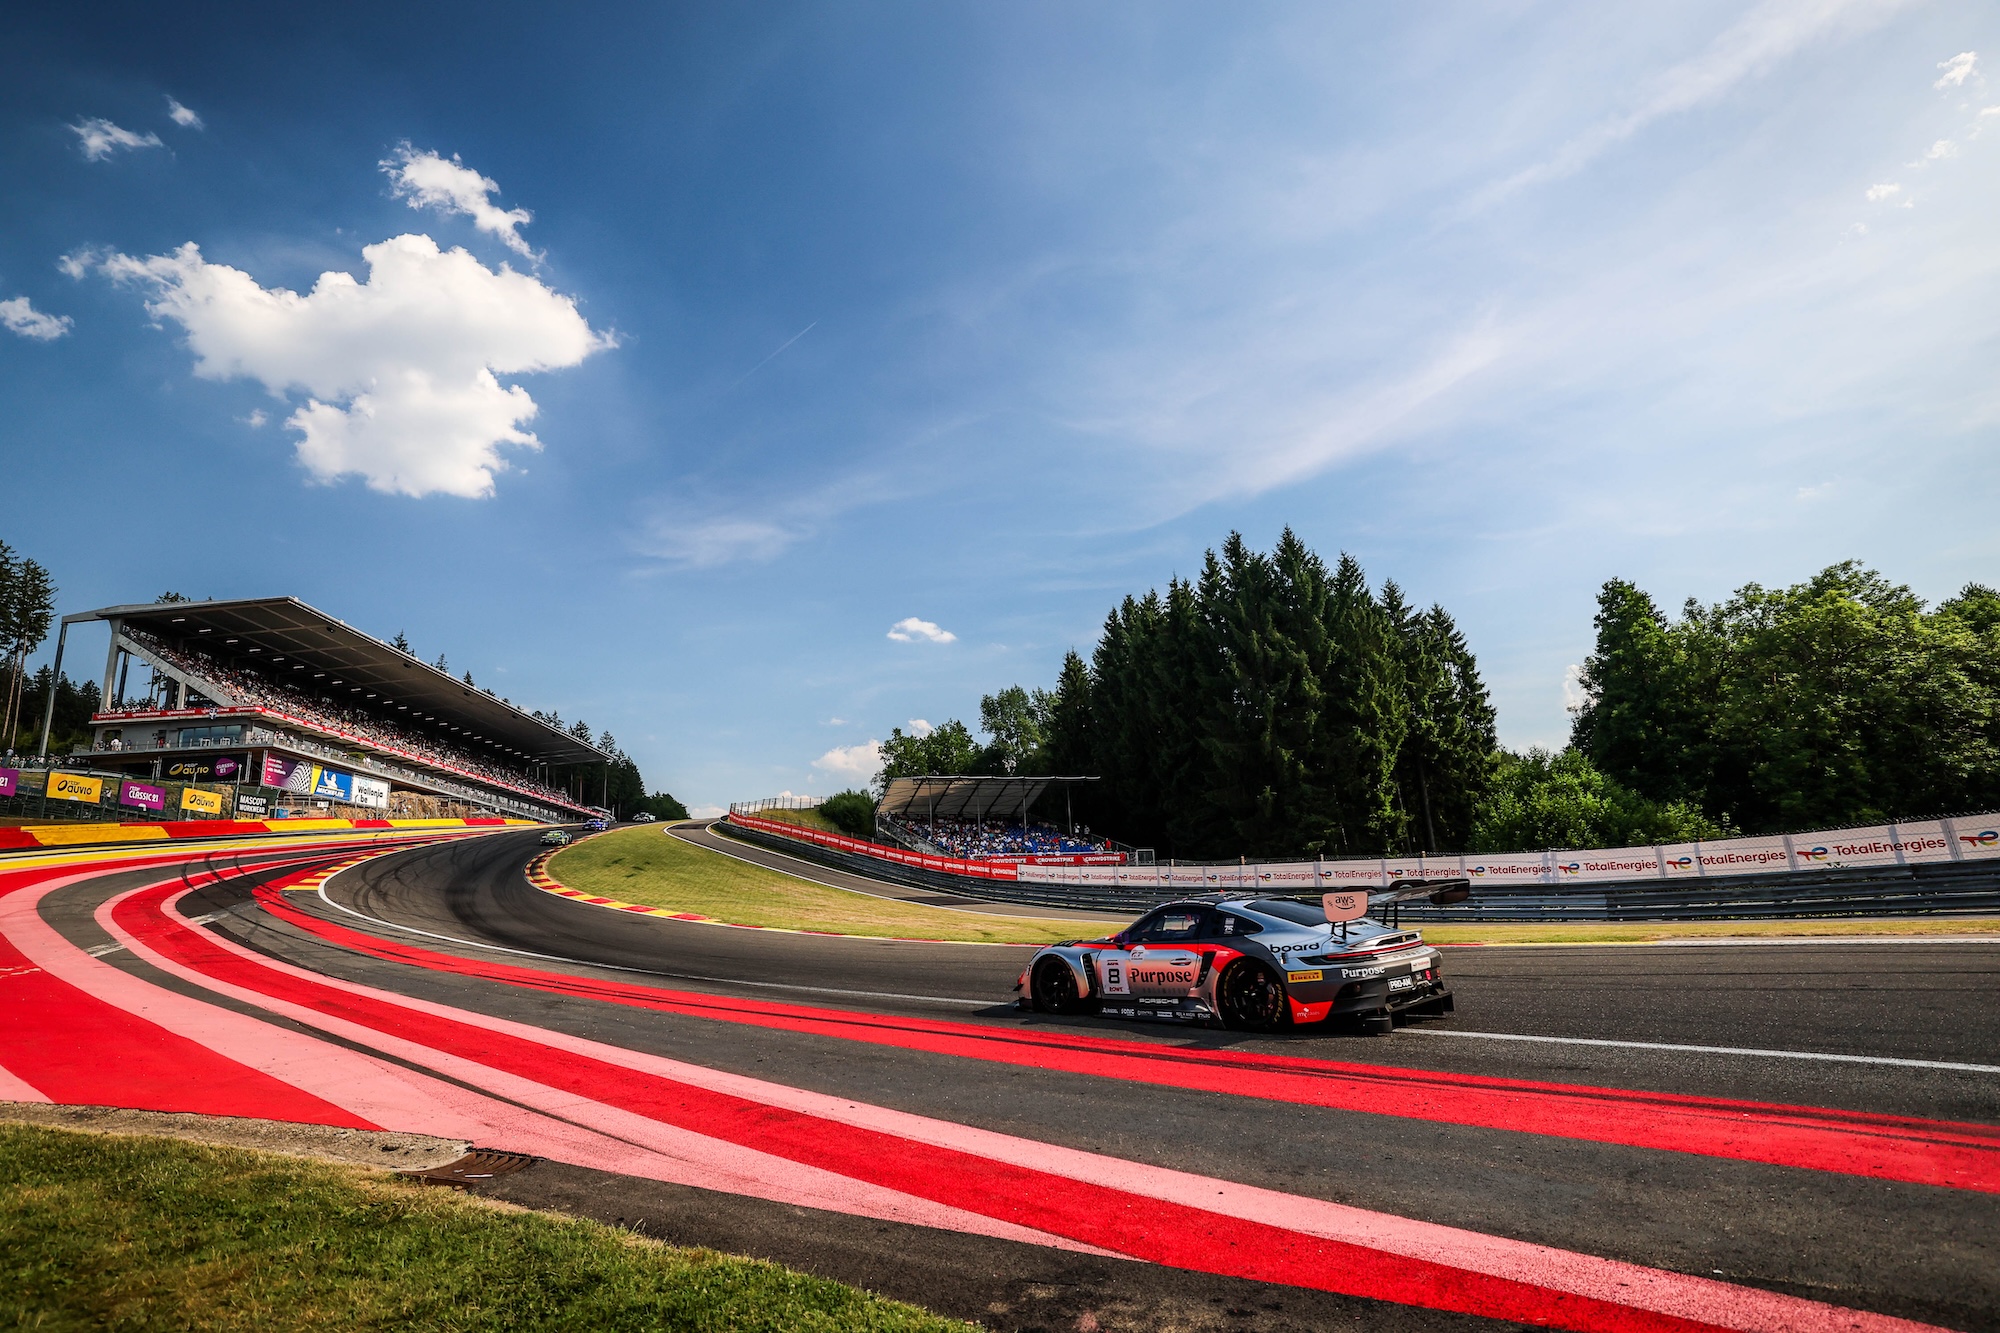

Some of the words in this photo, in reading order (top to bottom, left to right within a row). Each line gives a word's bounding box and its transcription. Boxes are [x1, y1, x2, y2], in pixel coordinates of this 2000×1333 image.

[67, 785, 92, 795] auvio
[129, 790, 152, 802] CLASSIC
[151, 794, 159, 802] 21
[196, 798, 215, 807] auvio
[239, 804, 266, 814] WORKWEAR
[1833, 838, 1946, 856] TotalEnergies
[1695, 850, 1787, 866] TotalEnergies
[1488, 865, 1552, 876] TotalEnergies
[1583, 860, 1658, 872] TotalEnergies
[1025, 871, 1047, 879] TotalEnergies
[1056, 872, 1080, 880] TotalEnergies
[1090, 873, 1117, 881] TotalEnergies
[1128, 873, 1158, 882] TotalEnergies
[1171, 874, 1204, 882] TotalEnergies
[1219, 874, 1255, 882] TotalEnergies
[1273, 872, 1314, 881] TotalEnergies
[1334, 870, 1383, 880] TotalEnergies
[1406, 868, 1461, 878] TotalEnergies
[1335, 896, 1355, 904] aws
[1270, 942, 1320, 953] board
[1108, 968, 1120, 984] 8
[1130, 968, 1192, 986] Purpose
[1290, 972, 1320, 981] PIRELLI
[1341, 966, 1386, 979] Purpose
[1390, 977, 1412, 989] PRO-AM
